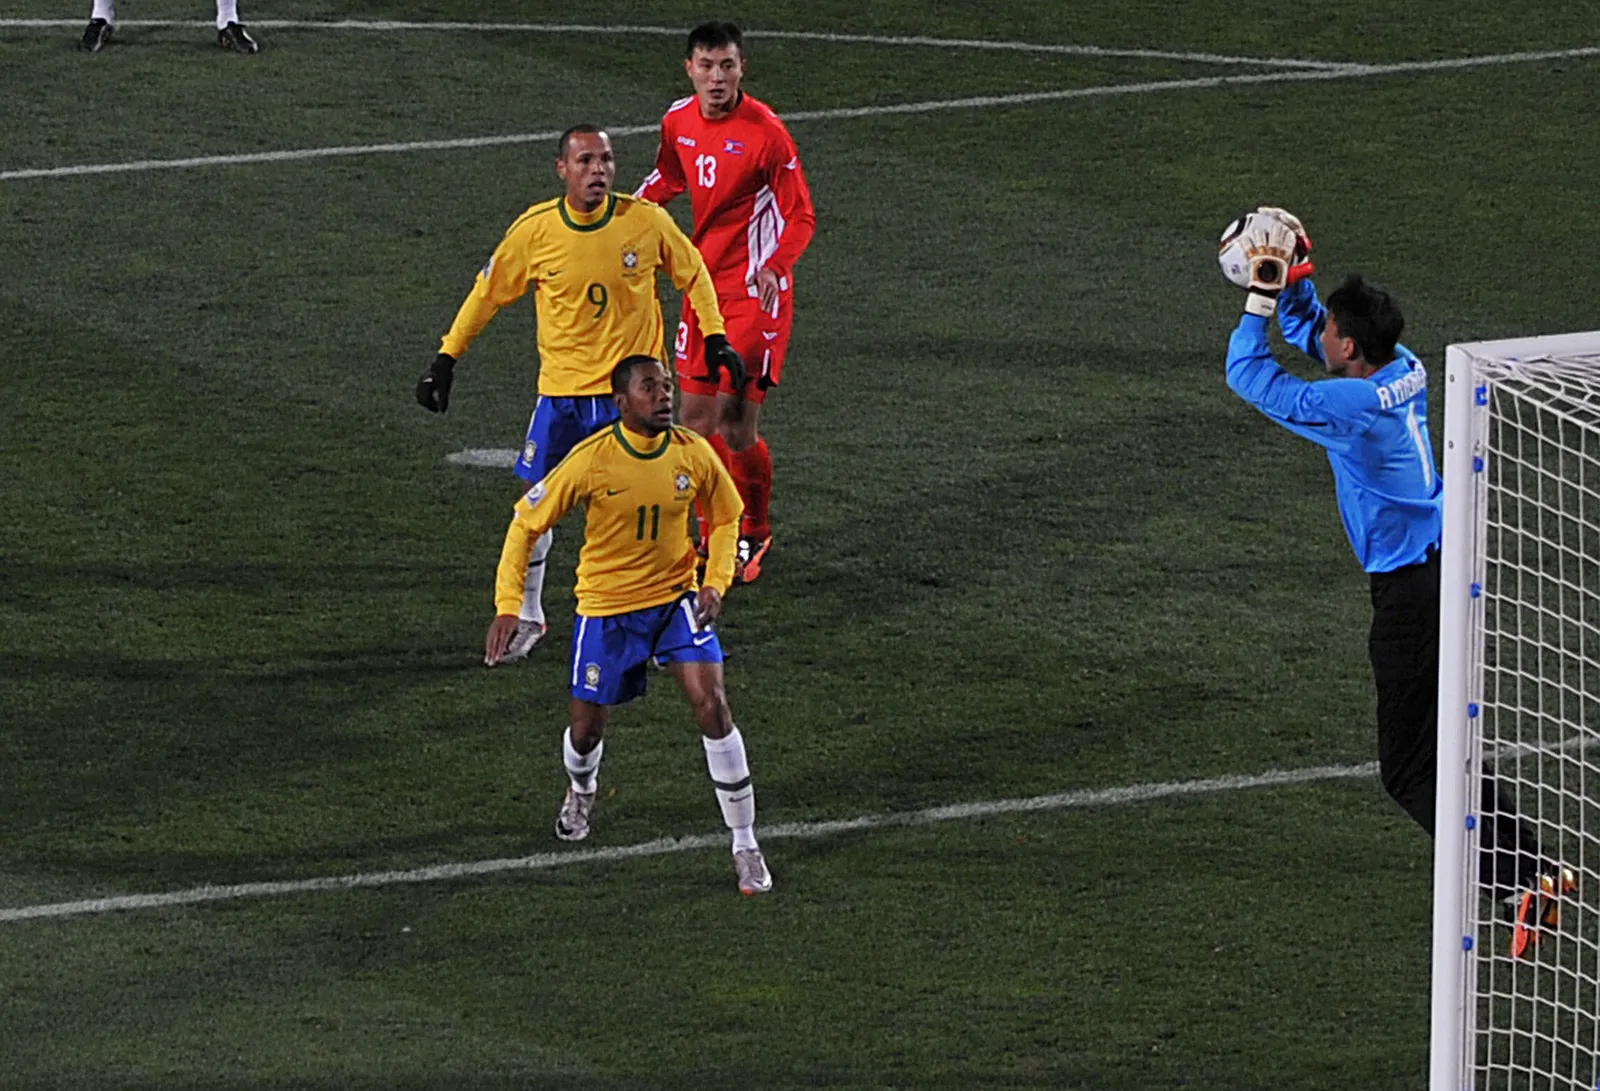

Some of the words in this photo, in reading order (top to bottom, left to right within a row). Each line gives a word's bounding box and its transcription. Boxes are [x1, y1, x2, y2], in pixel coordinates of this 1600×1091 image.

[695, 153, 717, 188] 13
[587, 282, 608, 319] 9
[1406, 401, 1432, 487] 1
[636, 503, 661, 541] 11
